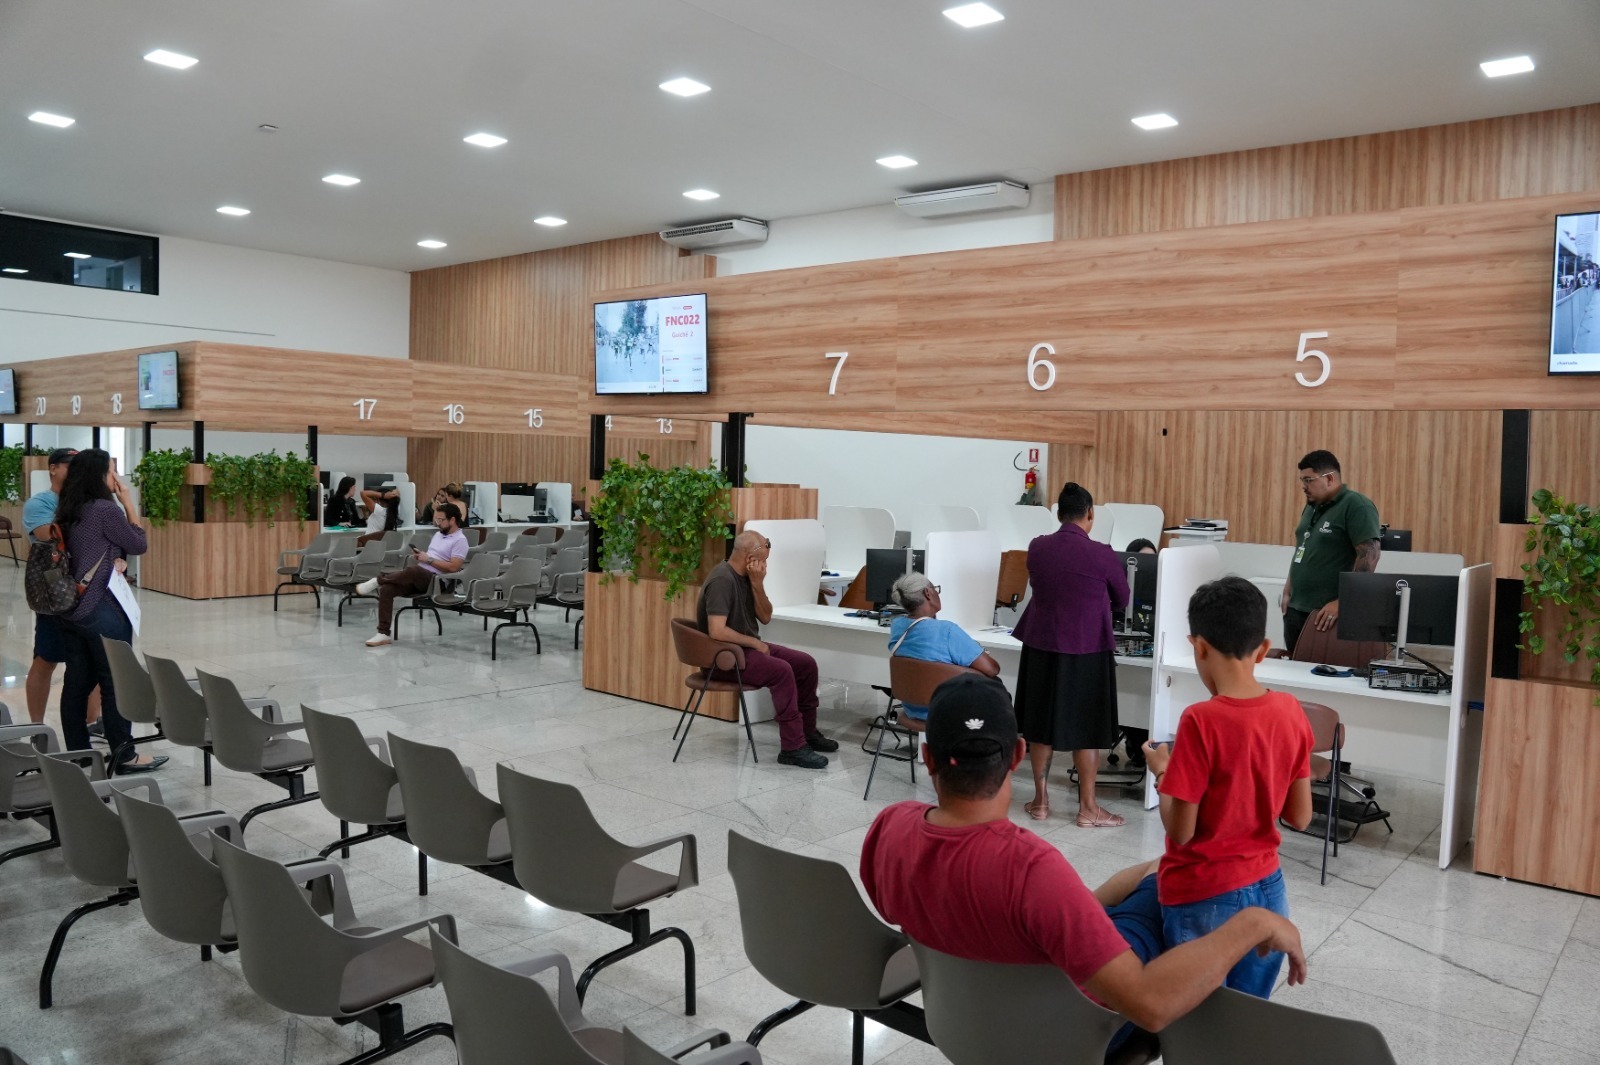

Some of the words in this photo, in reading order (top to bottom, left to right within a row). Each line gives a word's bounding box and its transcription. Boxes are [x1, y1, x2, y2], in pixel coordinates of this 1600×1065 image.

[665, 314, 700, 326] FNC022
[1026, 342, 1058, 391] 6
[1294, 330, 1333, 388] 5
[824, 351, 850, 396] 7
[35, 396, 47, 416] 20
[70, 395, 82, 416] 19
[111, 392, 122, 415] 18
[353, 398, 378, 420] 17
[442, 404, 465, 425] 16
[523, 408, 544, 429] 15
[604, 415, 613, 431] 4
[656, 417, 673, 434] 13
